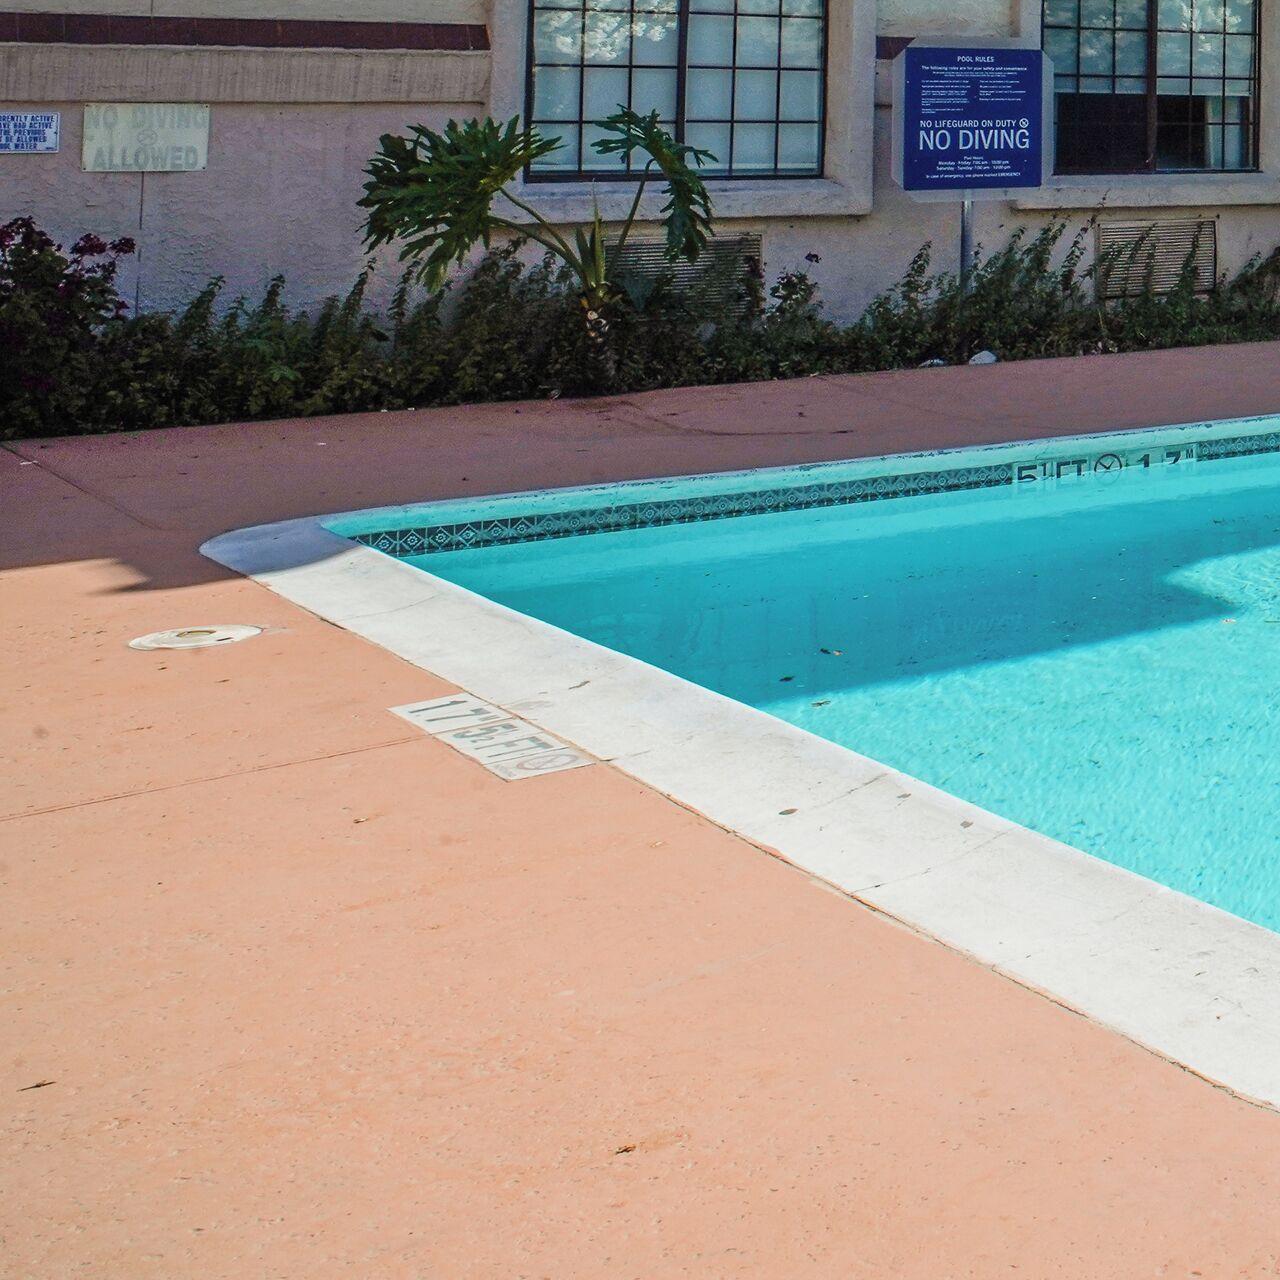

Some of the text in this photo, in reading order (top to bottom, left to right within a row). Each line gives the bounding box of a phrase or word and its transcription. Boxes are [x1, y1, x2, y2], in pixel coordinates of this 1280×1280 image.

[86, 106, 119, 129] NO
[920, 119, 1016, 128] NO LIFEGUARD ON DUTY
[919, 129, 1030, 150] NO DIVING
[93, 145, 199, 170] ALLOWED
